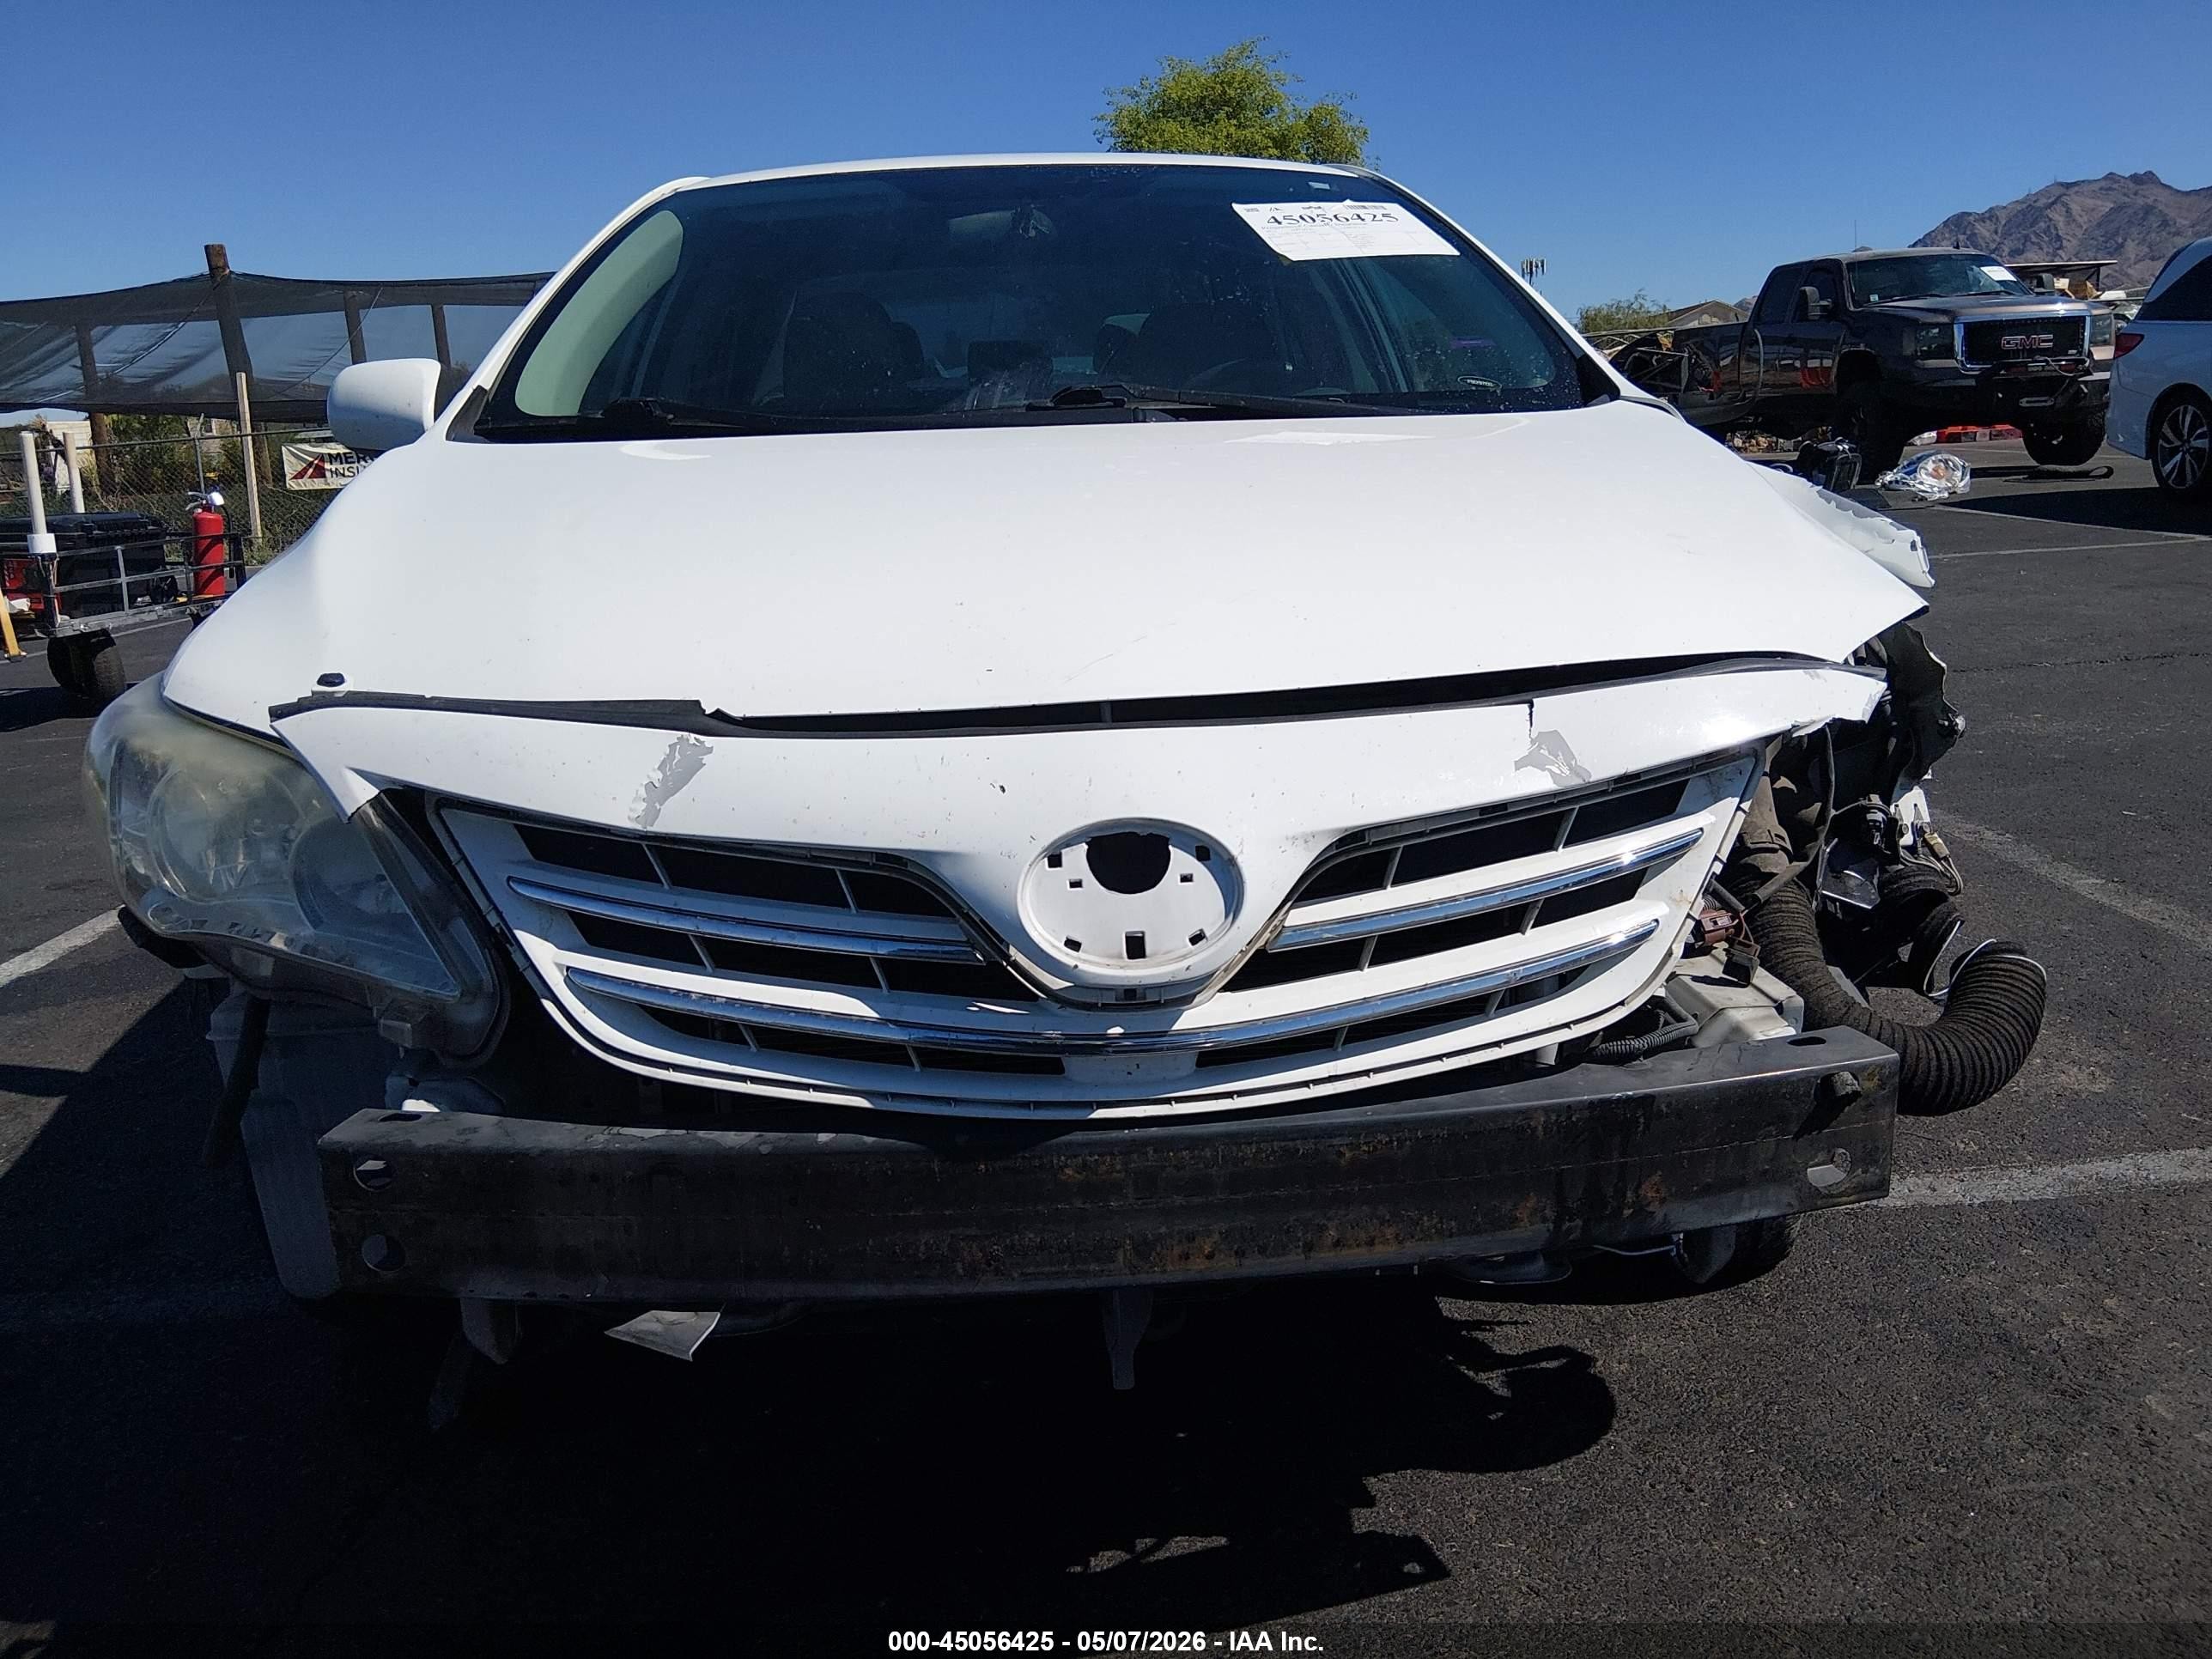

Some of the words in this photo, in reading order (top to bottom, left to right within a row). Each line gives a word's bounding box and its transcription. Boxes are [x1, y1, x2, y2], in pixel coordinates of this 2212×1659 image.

[1267, 212, 1399, 226] 45056425
[2001, 334, 2054, 349] GMC
[328, 452, 374, 465] MER
